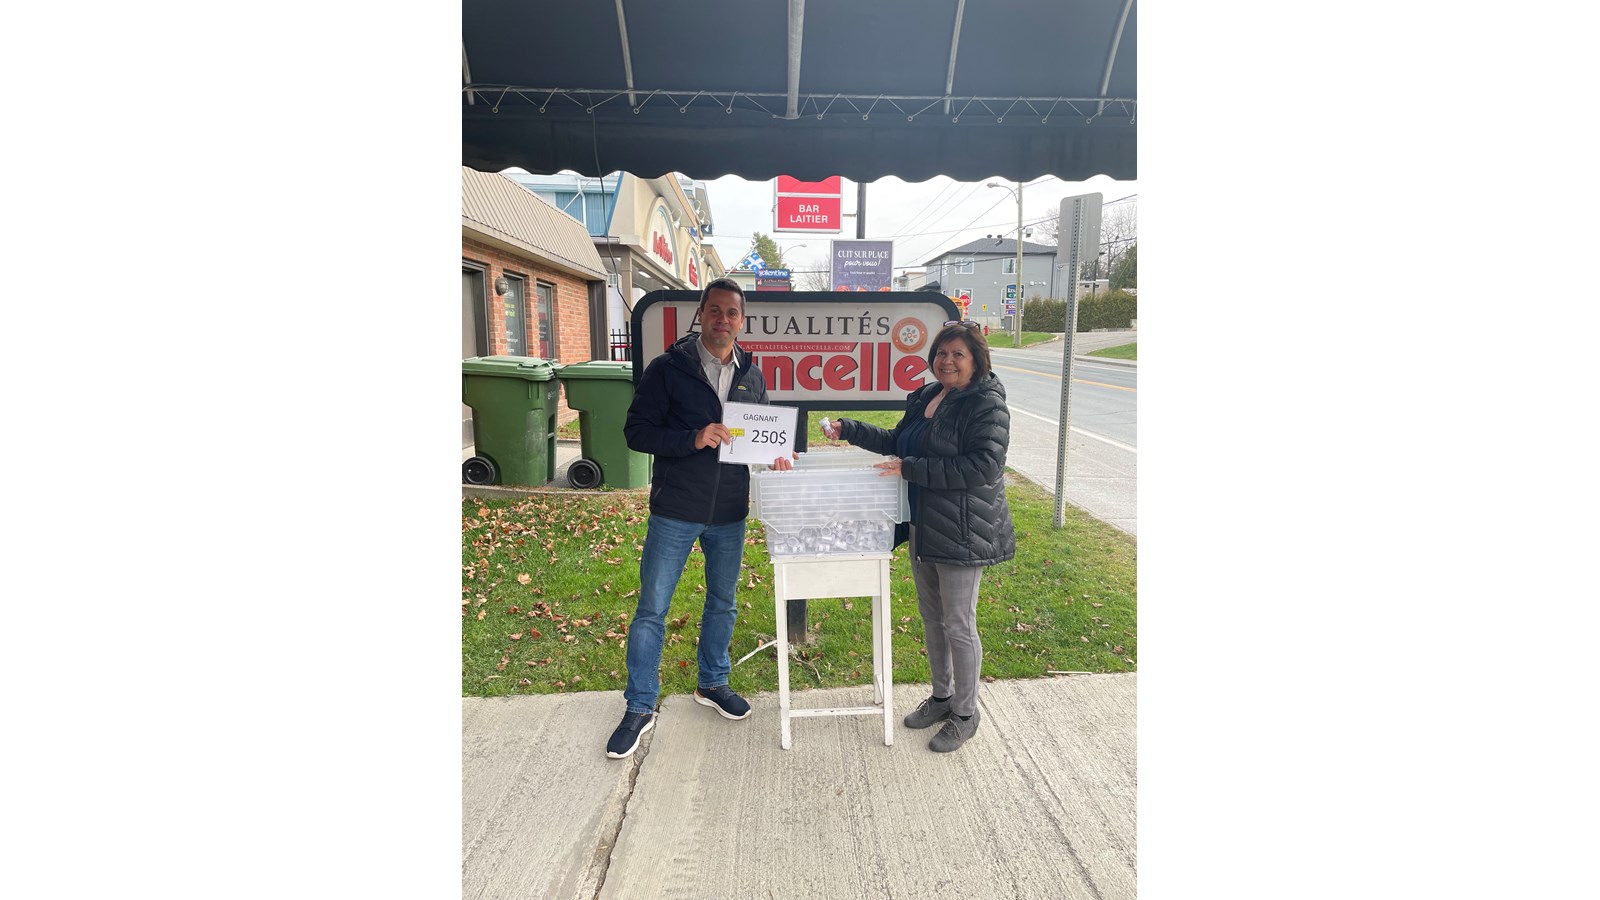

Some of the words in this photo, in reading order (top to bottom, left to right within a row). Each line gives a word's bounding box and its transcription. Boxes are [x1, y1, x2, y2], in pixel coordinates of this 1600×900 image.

[799, 205, 819, 213] BAR
[790, 215, 828, 223] LAITIER
[838, 250, 853, 258] CUIT
[854, 250, 867, 258] SUR
[868, 250, 889, 259] PLACE
[844, 260, 862, 268] pour
[687, 308, 890, 335] ATUALITÉS
[743, 413, 778, 422] GAGNANT
[751, 430, 787, 446] 250$
